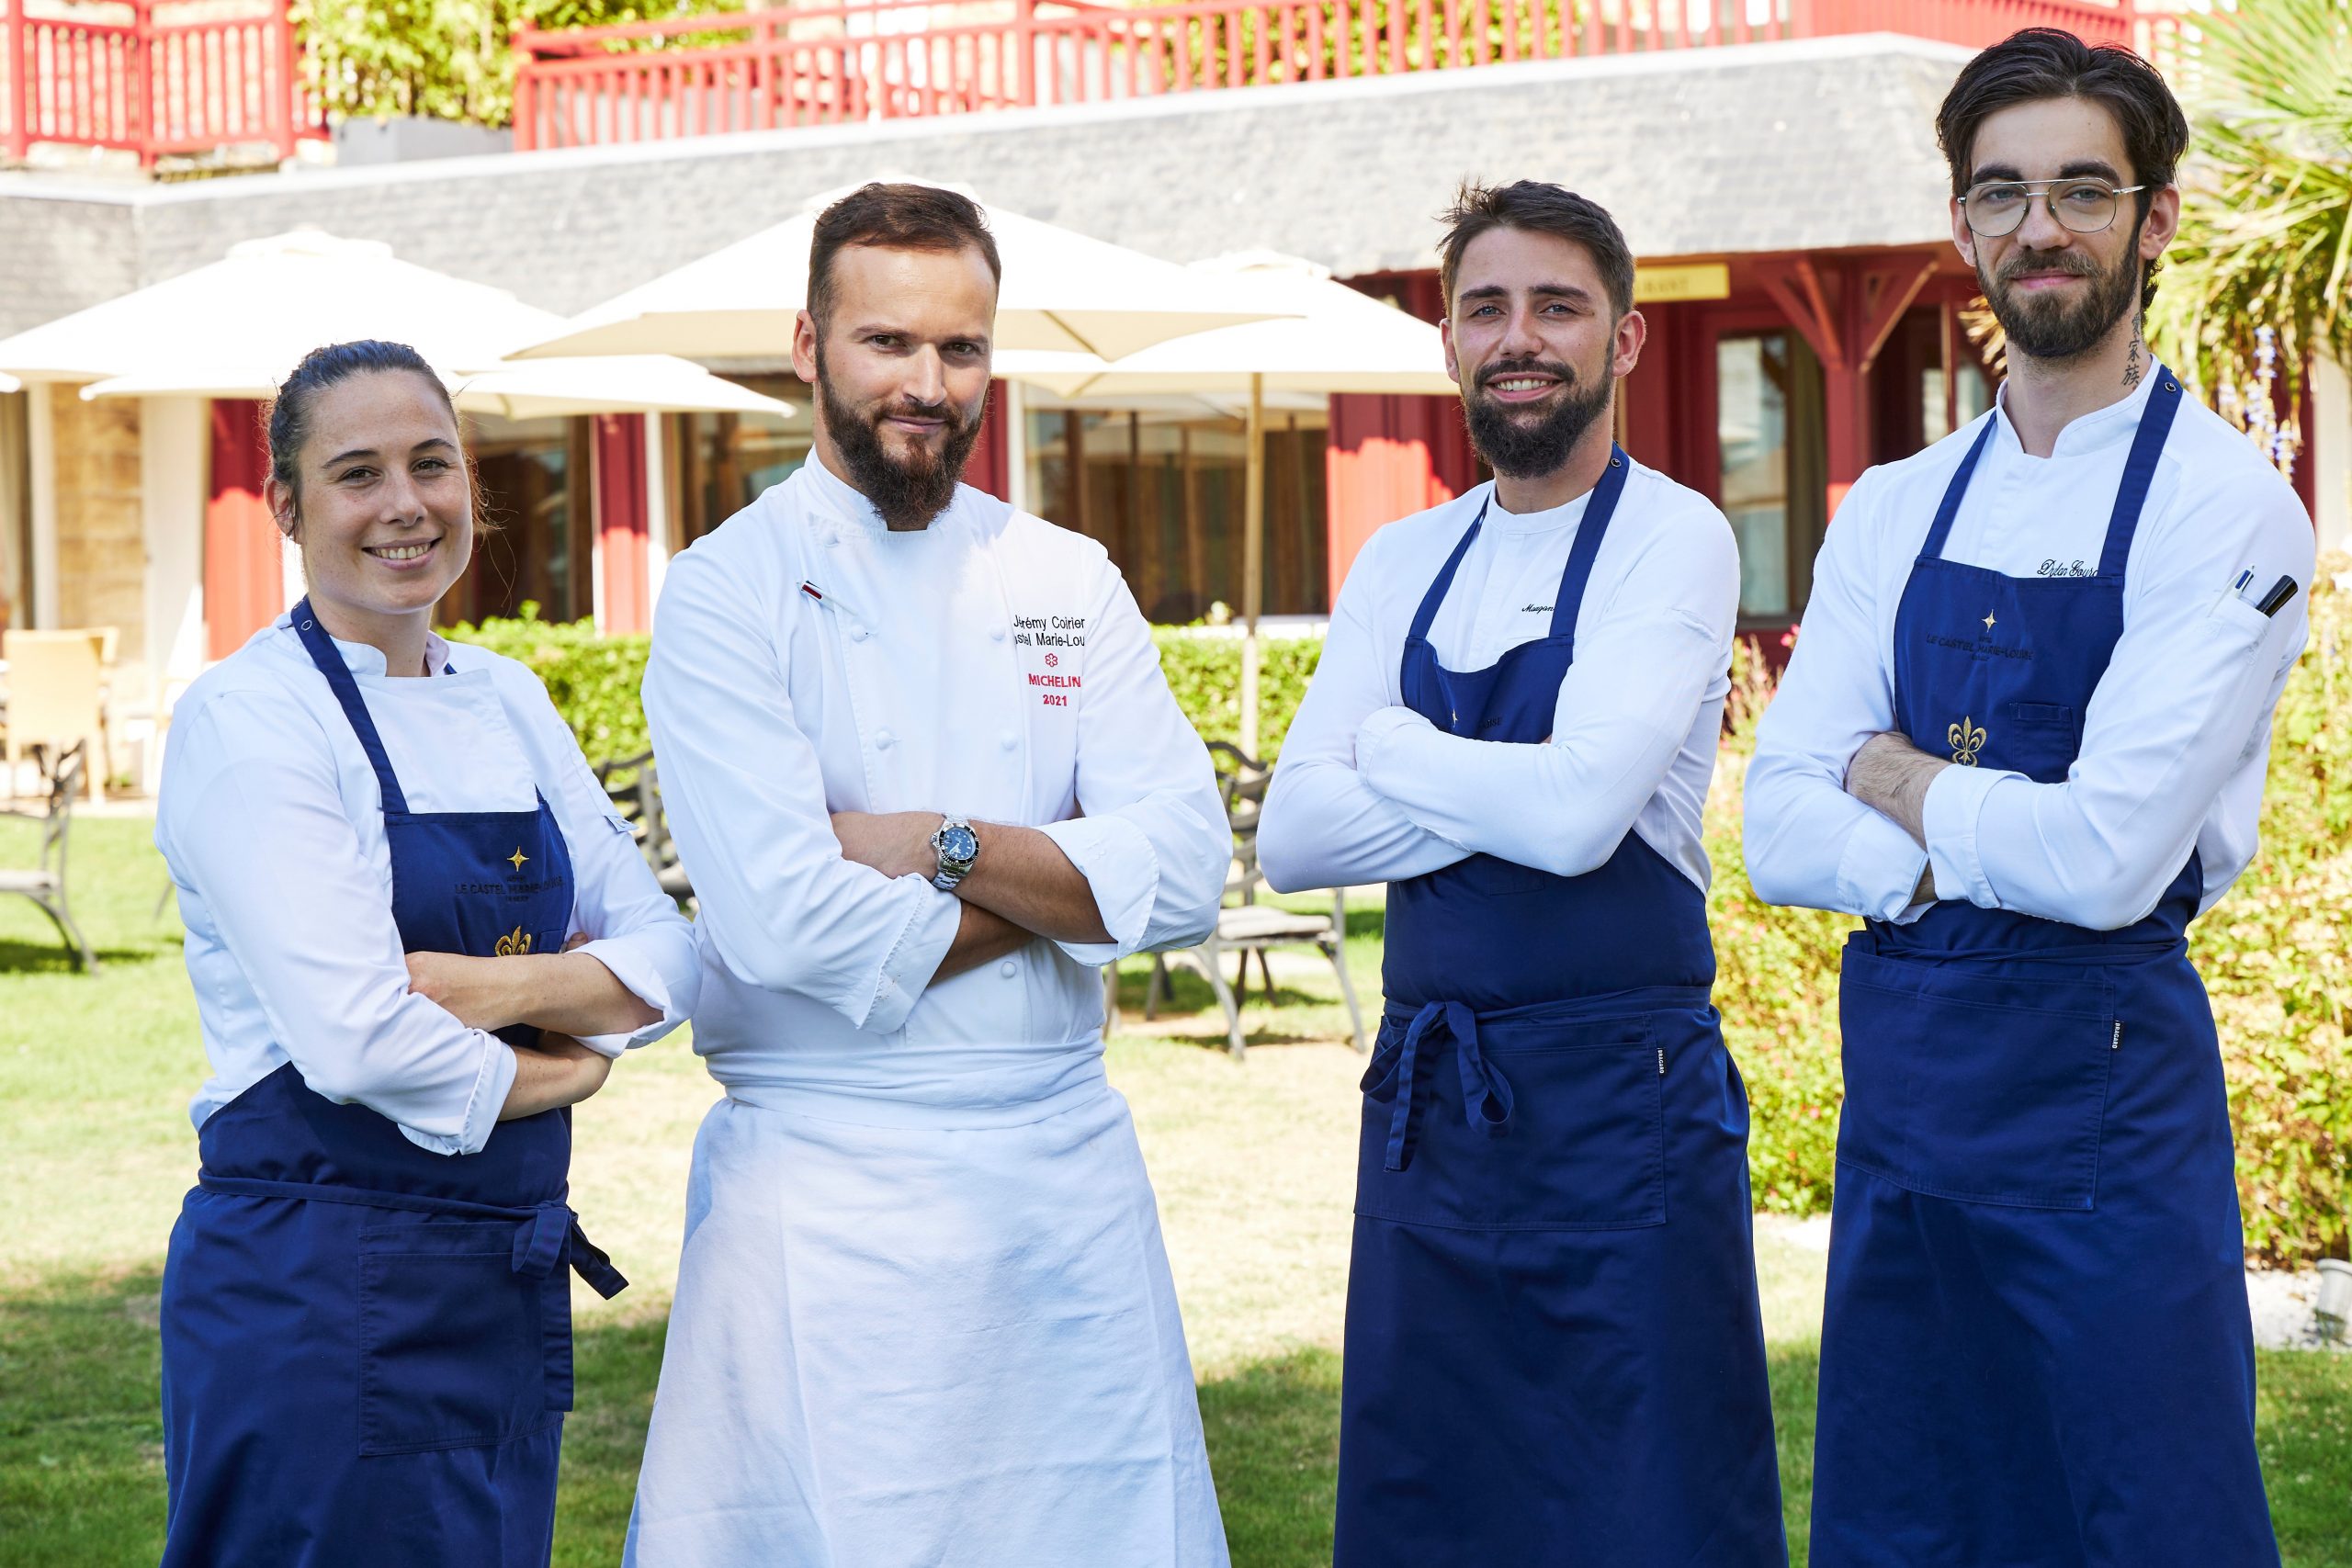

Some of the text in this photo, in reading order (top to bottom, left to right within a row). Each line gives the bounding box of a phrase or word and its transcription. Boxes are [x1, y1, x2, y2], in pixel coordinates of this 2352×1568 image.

[1013, 615, 1085, 631] Jérémy Coirier
[1938, 637, 1974, 653] CASTEL
[1028, 673, 1081, 688] MICHELIN
[1043, 694, 1068, 706] 2021
[455, 884, 468, 895] LE
[469, 884, 506, 895] CASTEL
[2111, 1022, 2120, 1049] BRAGARD
